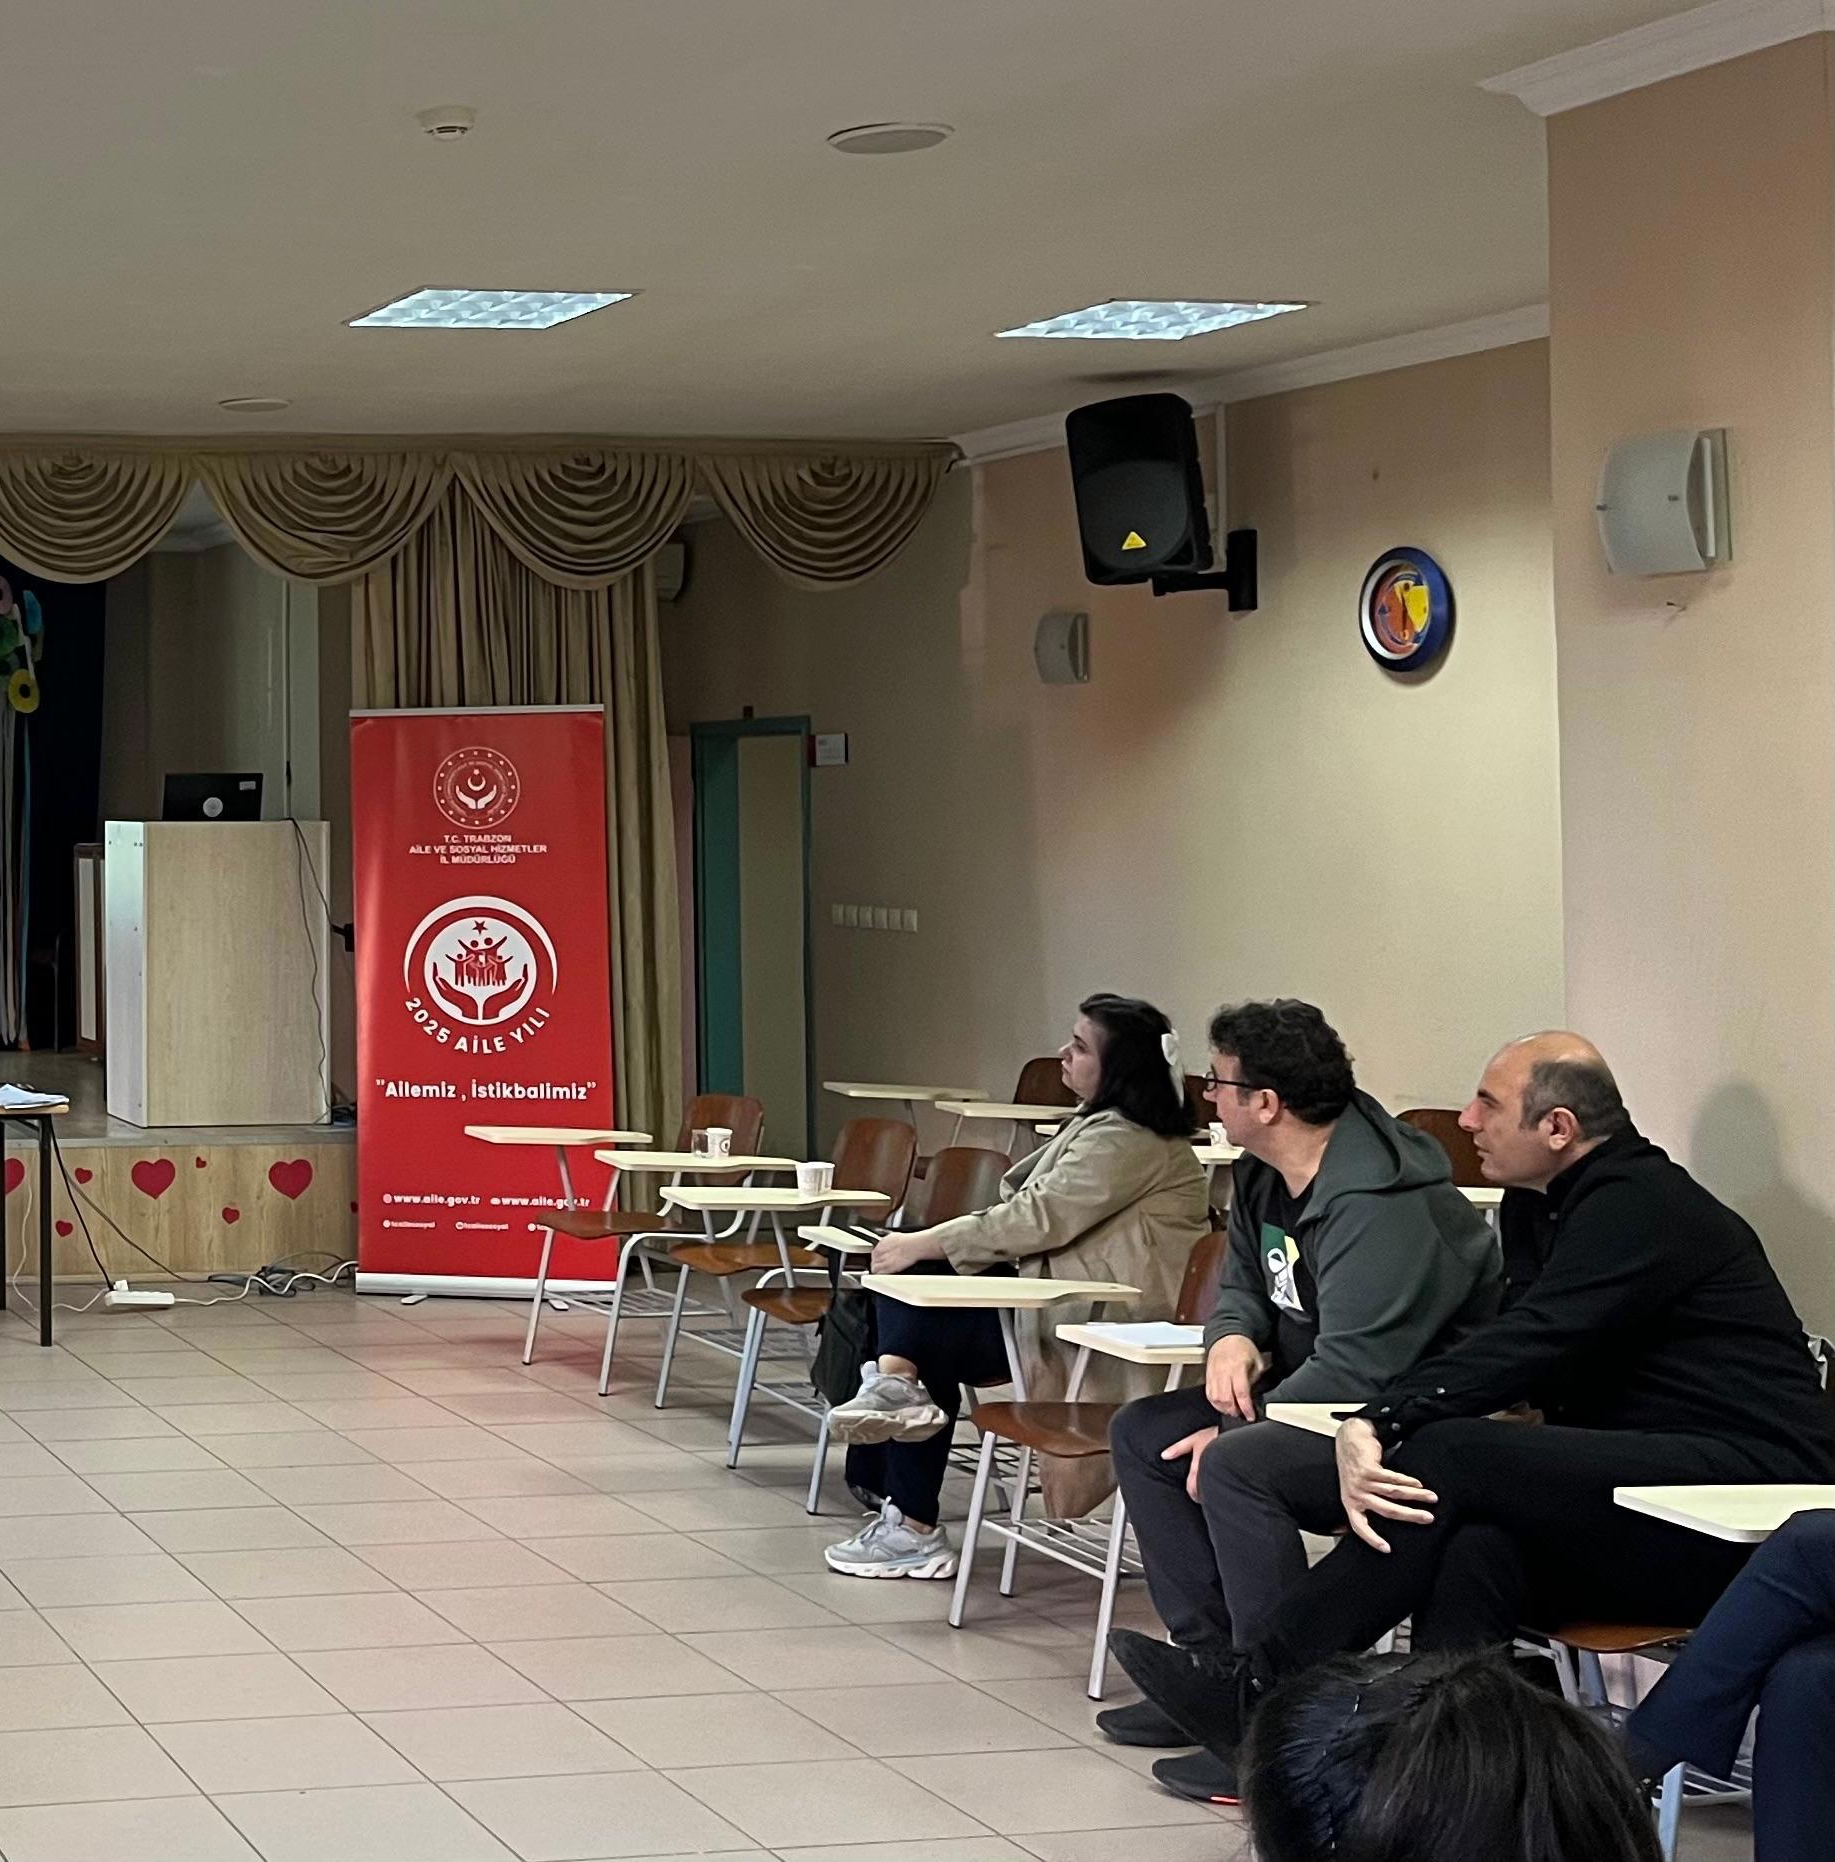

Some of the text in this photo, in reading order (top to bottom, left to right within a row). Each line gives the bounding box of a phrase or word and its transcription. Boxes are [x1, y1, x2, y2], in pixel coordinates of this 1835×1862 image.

[443, 834, 512, 844] T.C. TRABZON
[409, 844, 548, 855] AİLE VE SOSYAL HİZMETLER
[451, 854, 517, 865] MÜDÜRLÜĞÜ
[405, 997, 550, 1054] 2025 AİLE YILI
[393, 1193, 481, 1207] www.aile.gov.tr
